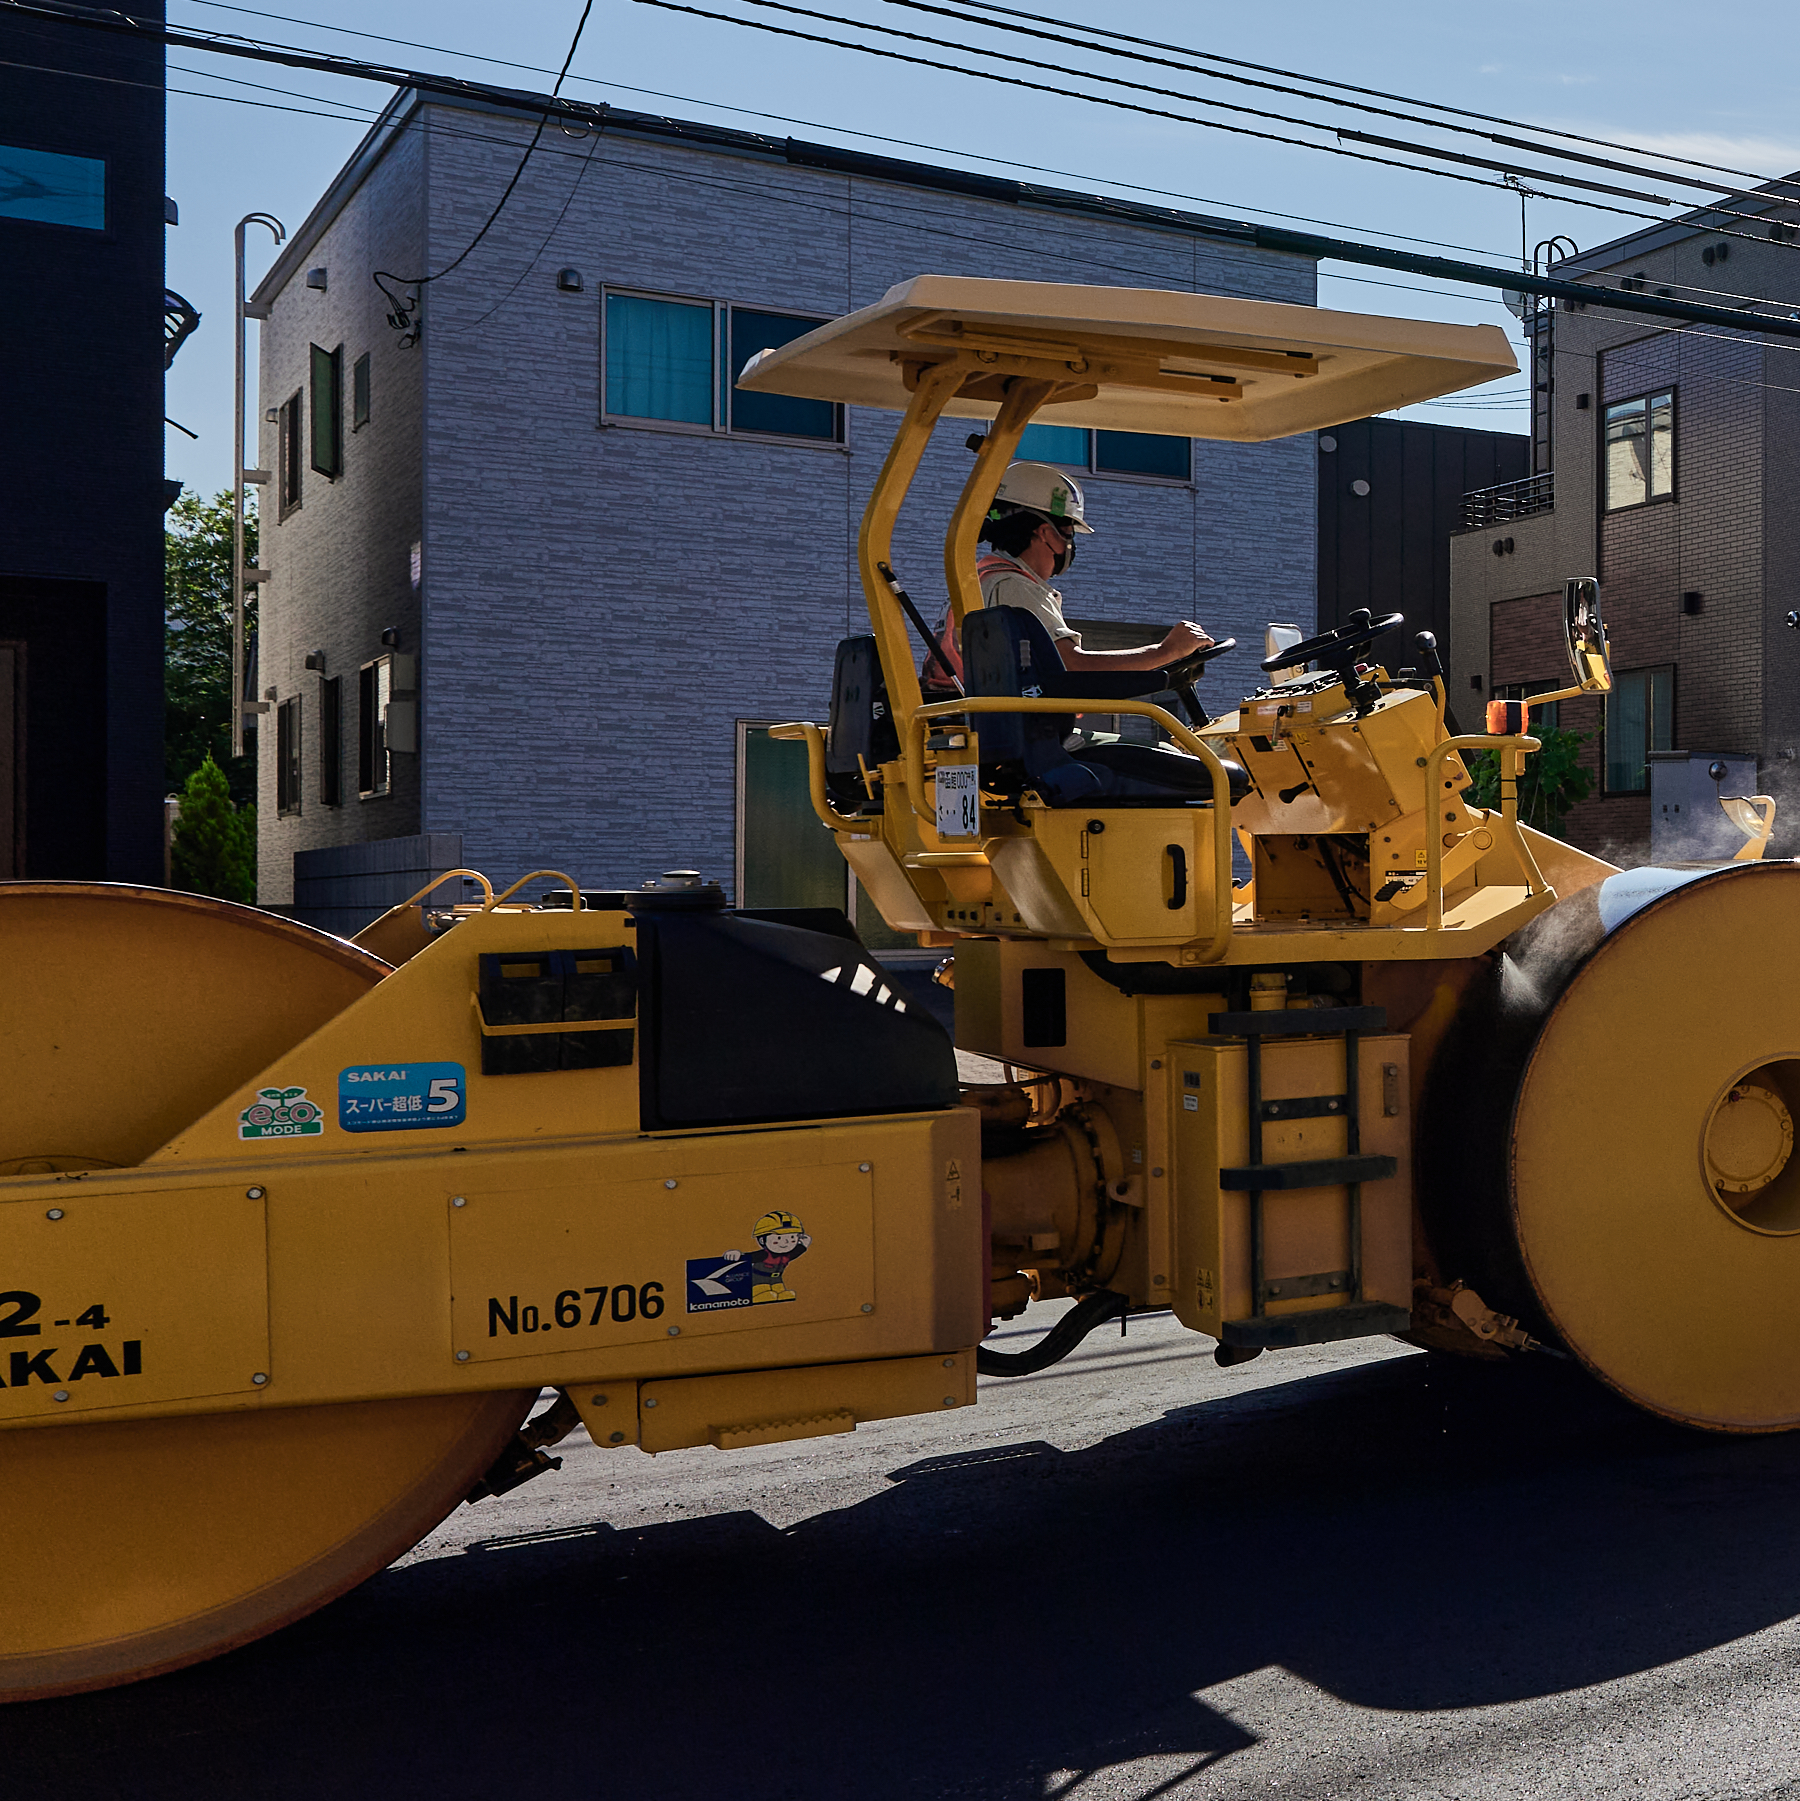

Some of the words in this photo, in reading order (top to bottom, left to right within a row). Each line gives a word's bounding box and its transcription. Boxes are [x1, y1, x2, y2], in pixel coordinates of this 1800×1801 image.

[347, 1070, 407, 1083] SAKAI
[346, 1094, 423, 1114] スーパー超低
[426, 1078, 460, 1112] 5
[248, 1101, 316, 1127] eco
[261, 1125, 302, 1136] MODE
[488, 1281, 665, 1337] No.6706
[690, 1298, 750, 1312] kanamoto
[0, 1340, 142, 1389] KAI
